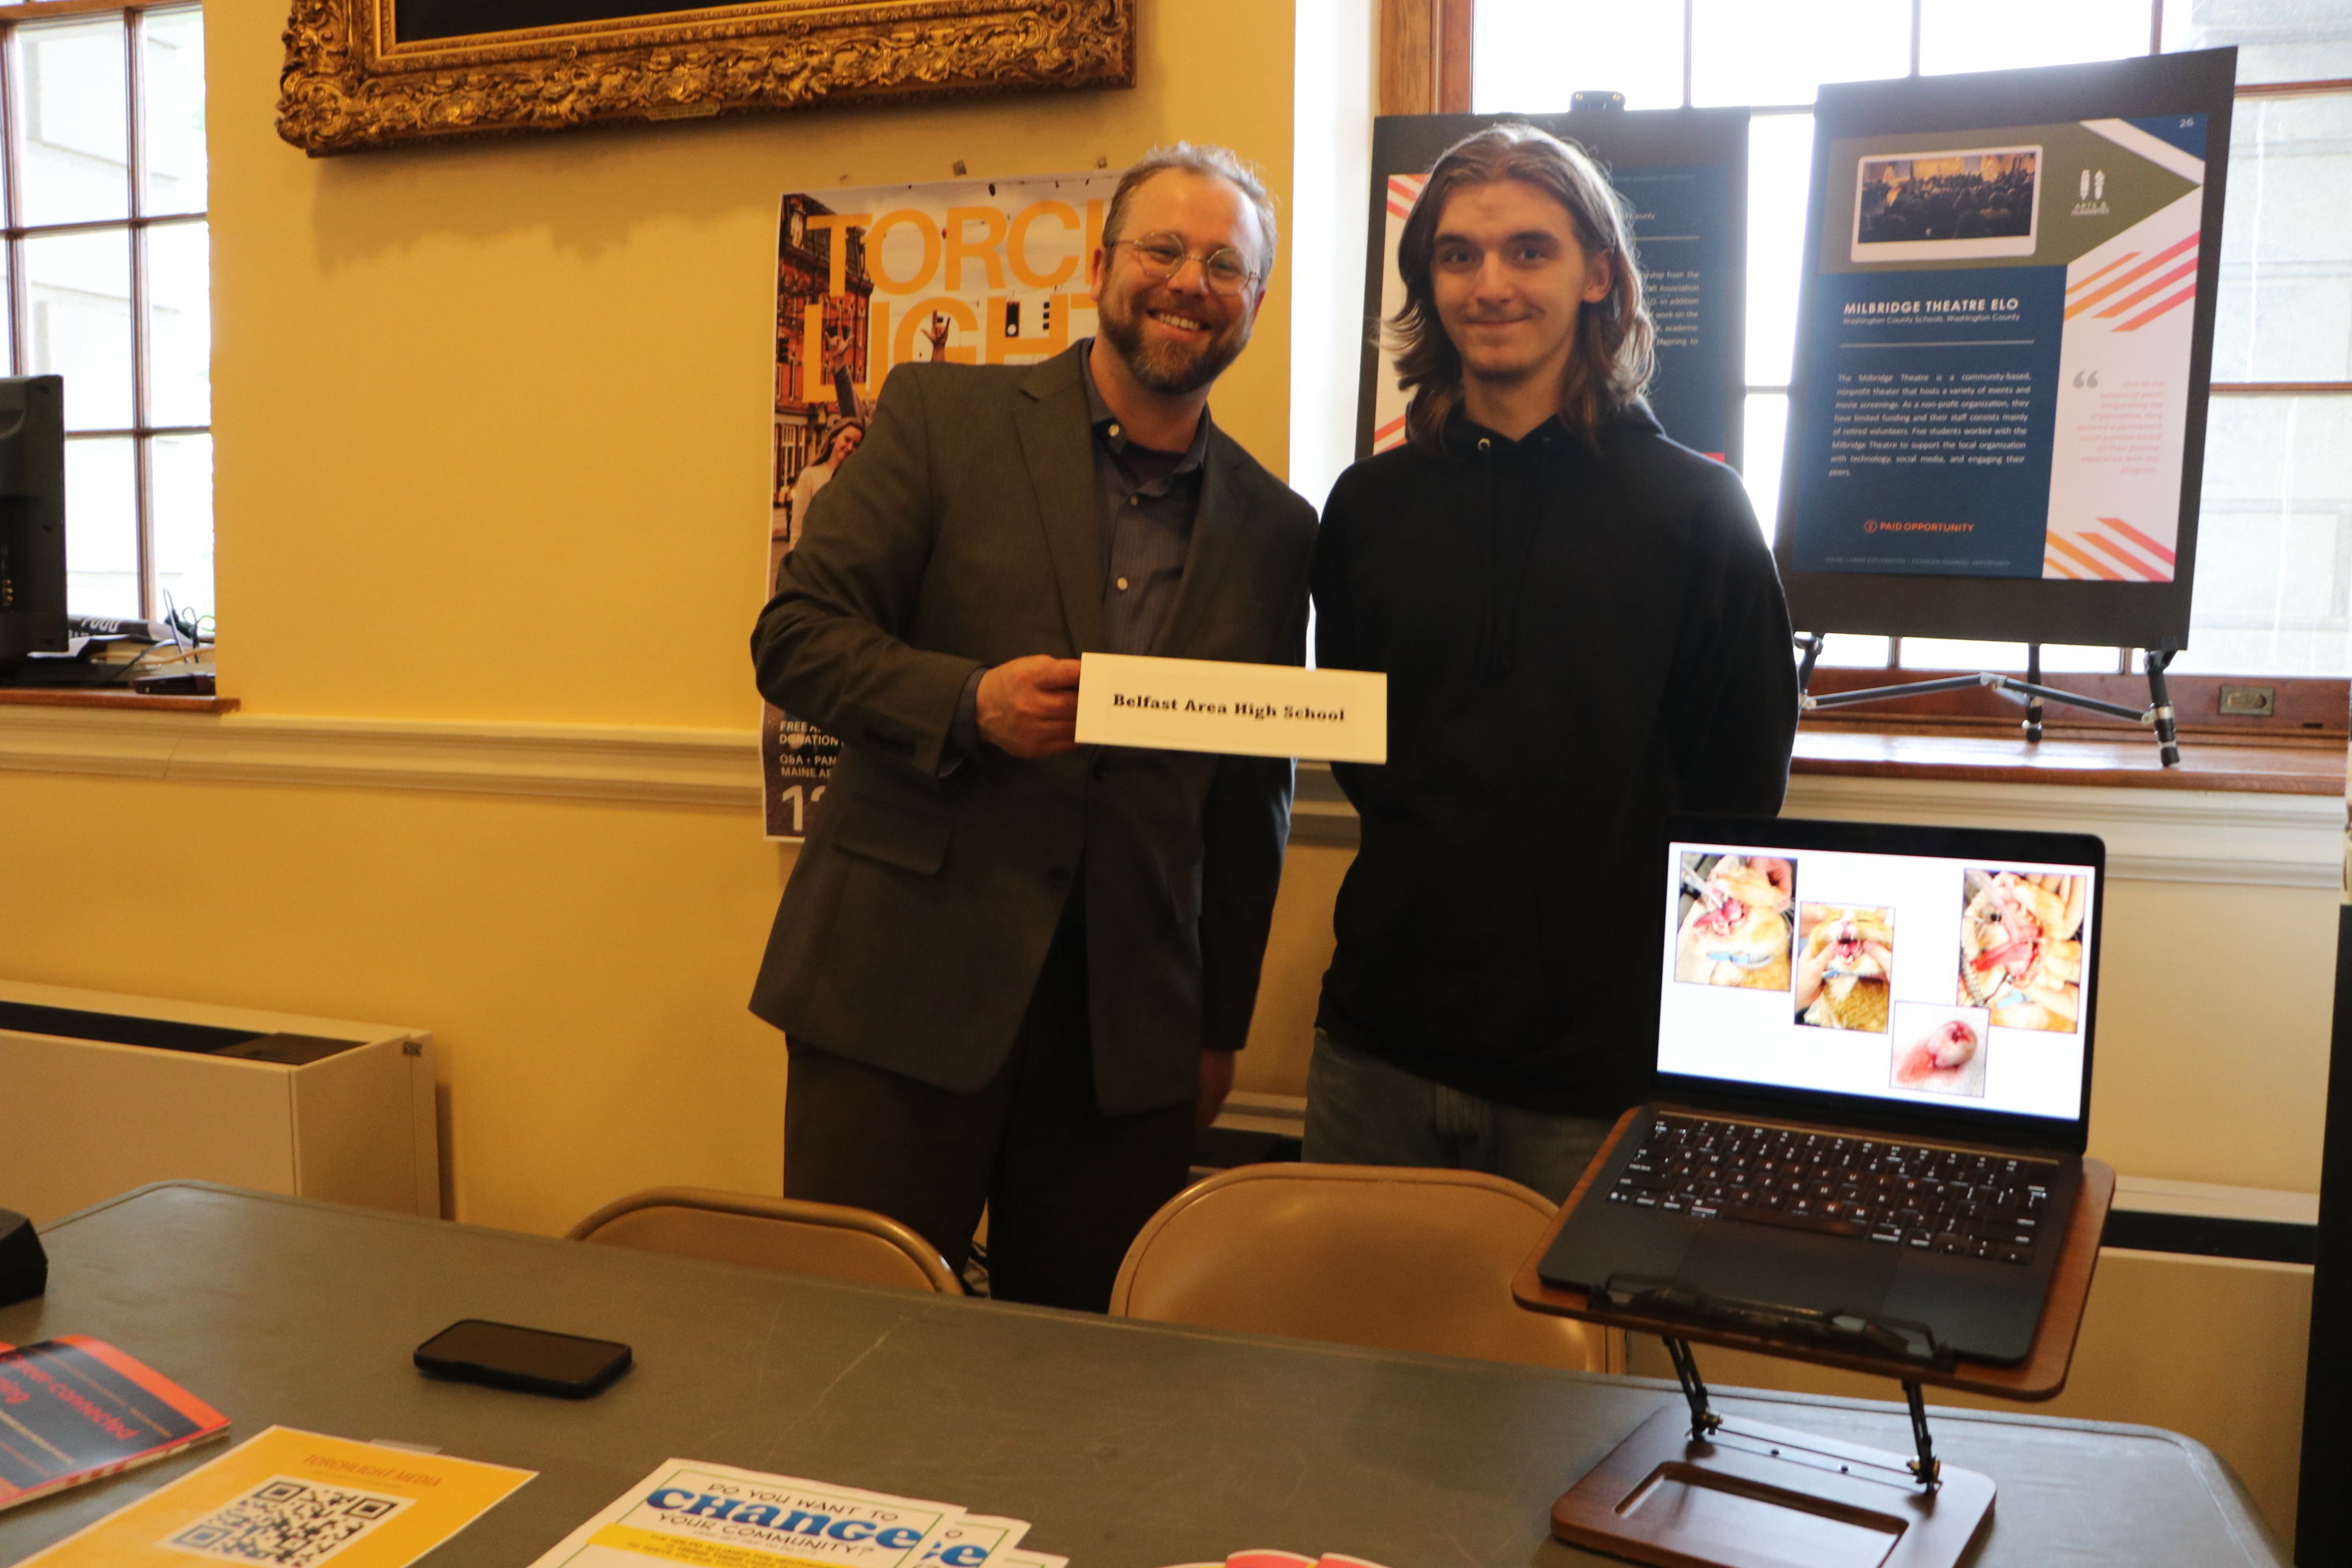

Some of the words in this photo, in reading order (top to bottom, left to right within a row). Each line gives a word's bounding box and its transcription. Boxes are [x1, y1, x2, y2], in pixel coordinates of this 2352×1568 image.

[2179, 117, 2194, 128] 26
[1843, 301, 1920, 315] MILBRIDGE
[1925, 299, 1986, 312] THEATRE
[1991, 298, 2019, 311] ELO
[1843, 317, 1885, 326] Washington
[1886, 316, 1913, 325] County
[1947, 314, 1990, 323] Washington
[1992, 313, 2019, 322] County
[1838, 373, 1852, 382] The
[1858, 373, 1894, 383] Milbridge
[1837, 387, 1871, 396] nonprofit
[1950, 386, 1975, 395] variety
[2011, 399, 2030, 409] they
[1882, 413, 1910, 423] funding
[2003, 413, 2028, 422] mainly
[1832, 441, 1866, 450] Milbridge
[1911, 442, 1939, 450] support
[1979, 441, 2026, 450] organization
[1967, 455, 2003, 465] engaging
[1879, 522, 1902, 531] PAID
[1904, 522, 1974, 533] OPPORTUNITY
[1113, 694, 1178, 711] Belfast
[1184, 699, 1227, 714] Area
[1234, 703, 1277, 720] High
[1283, 707, 1345, 724] School
[780, 721, 807, 733] FREE
[779, 733, 839, 746] DONATION
[780, 754, 803, 764] Q&A
[815, 756, 837, 766] PAN
[782, 767, 816, 778] MAINE
[708, 1483, 740, 1494] DO
[750, 1489, 790, 1504] YOU
[797, 1498, 861, 1514] WANT
[871, 1510, 899, 1522] TO
[659, 1512, 717, 1531] YOUR
